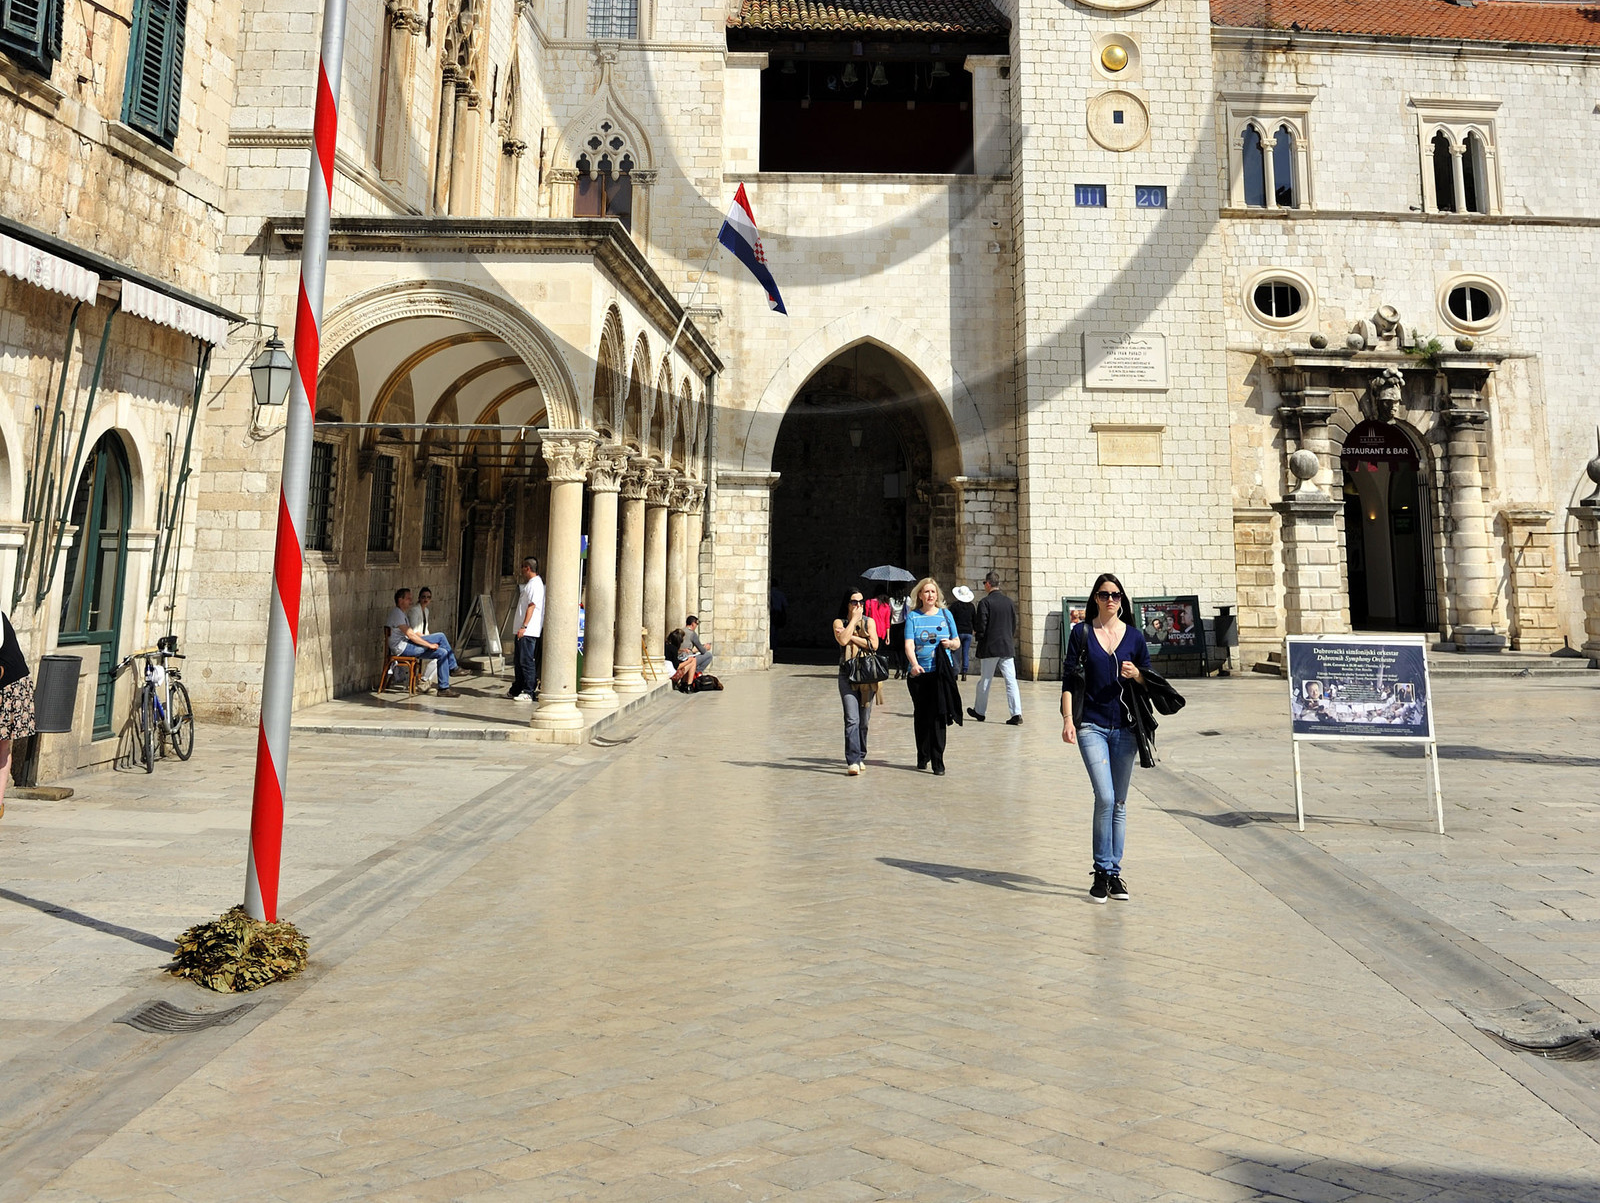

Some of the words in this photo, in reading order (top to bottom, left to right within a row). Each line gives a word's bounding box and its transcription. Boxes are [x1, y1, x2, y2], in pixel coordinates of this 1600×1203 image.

[1079, 187, 1101, 206] III
[1137, 189, 1161, 207] 20
[1342, 447, 1384, 455] ESTAURANT
[1386, 447, 1392, 455] &
[1393, 447, 1409, 455] BAR
